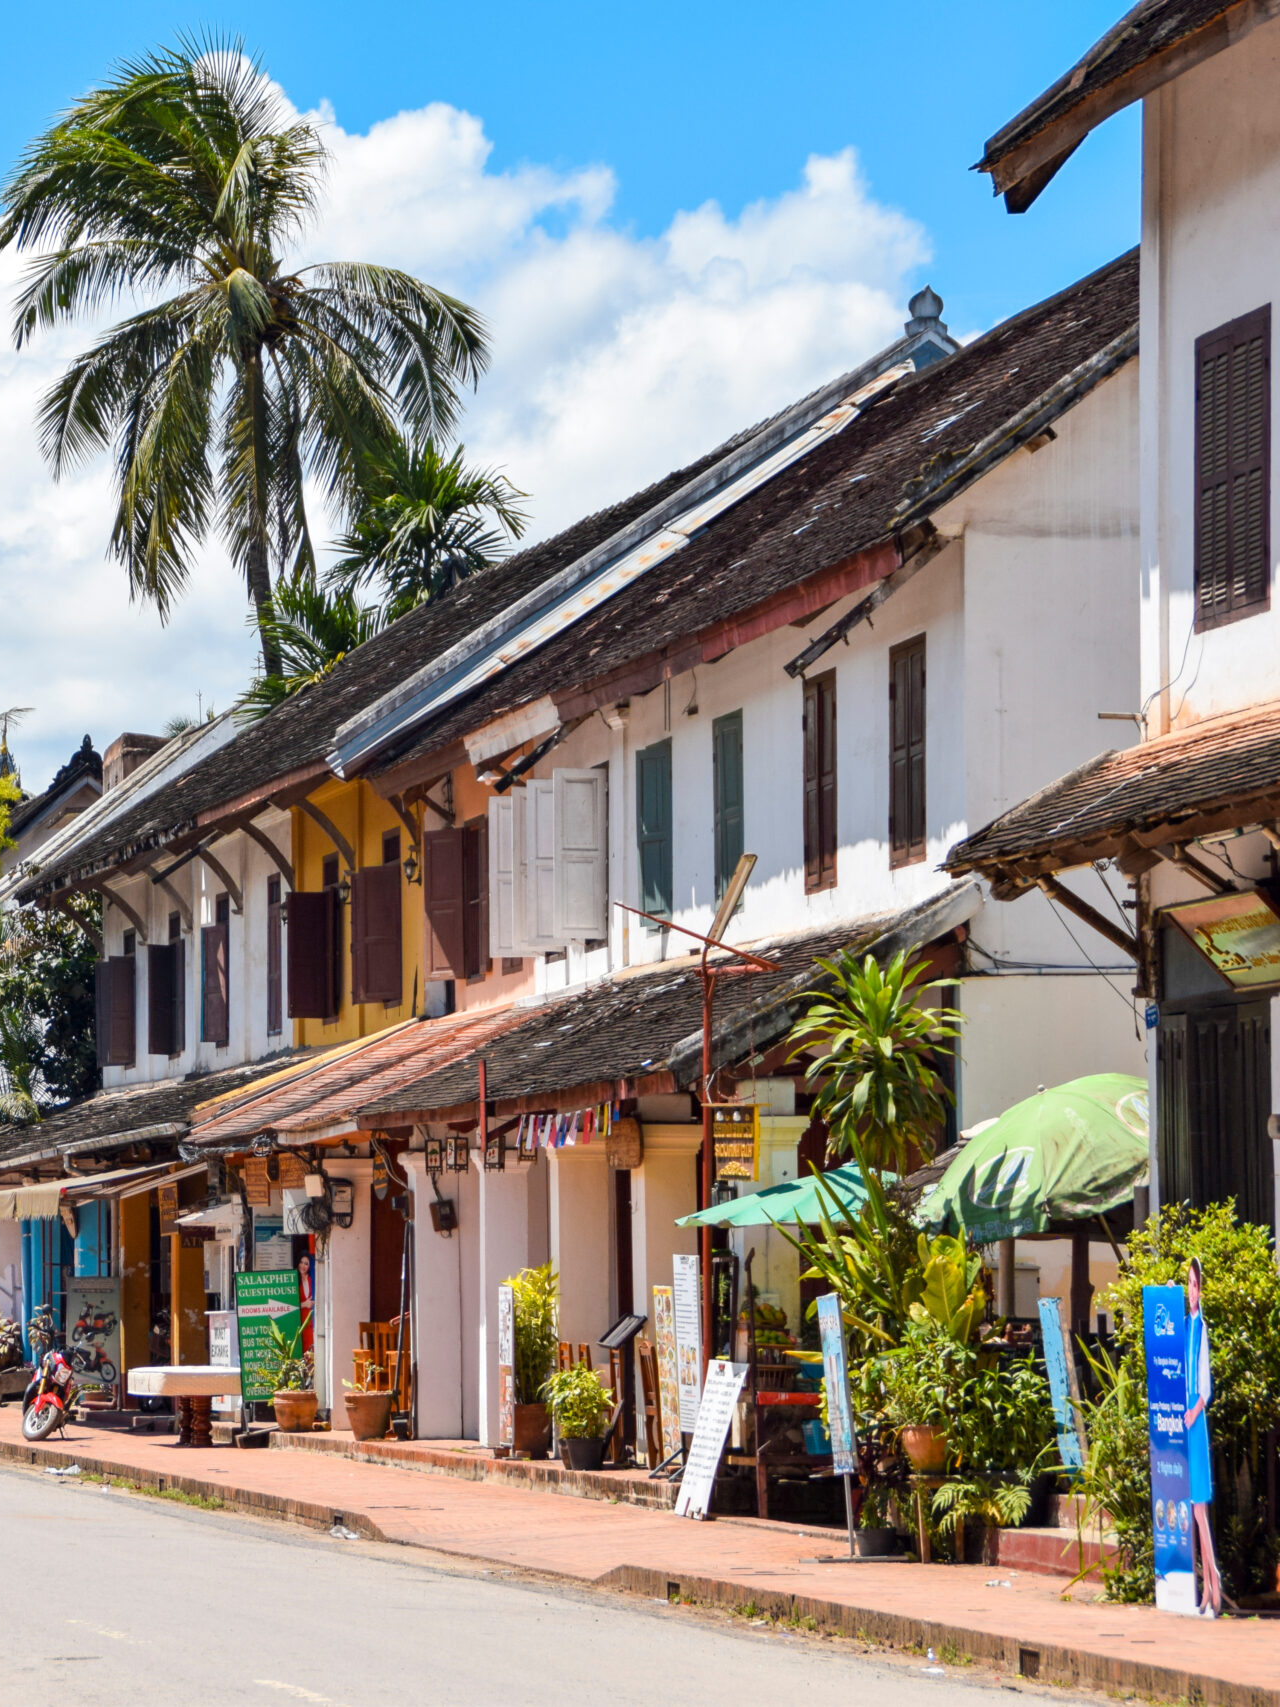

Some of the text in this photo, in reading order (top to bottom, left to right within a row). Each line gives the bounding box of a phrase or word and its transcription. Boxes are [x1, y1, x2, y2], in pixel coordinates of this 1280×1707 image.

[237, 1273, 296, 1286] SALAKPHET
[238, 1286, 297, 1298] GUESTHOUSE
[262, 1305, 291, 1313] AVAILABLE
[241, 1326, 258, 1336] DAILY
[242, 1338, 255, 1347] BUS
[211, 1345, 229, 1358] EXCHANGE
[244, 1350, 254, 1359] AIR
[244, 1362, 265, 1371] MONEY
[1157, 1413, 1184, 1436] Bangkok
[1162, 1462, 1173, 1477] flights
[1173, 1463, 1183, 1478] daily
